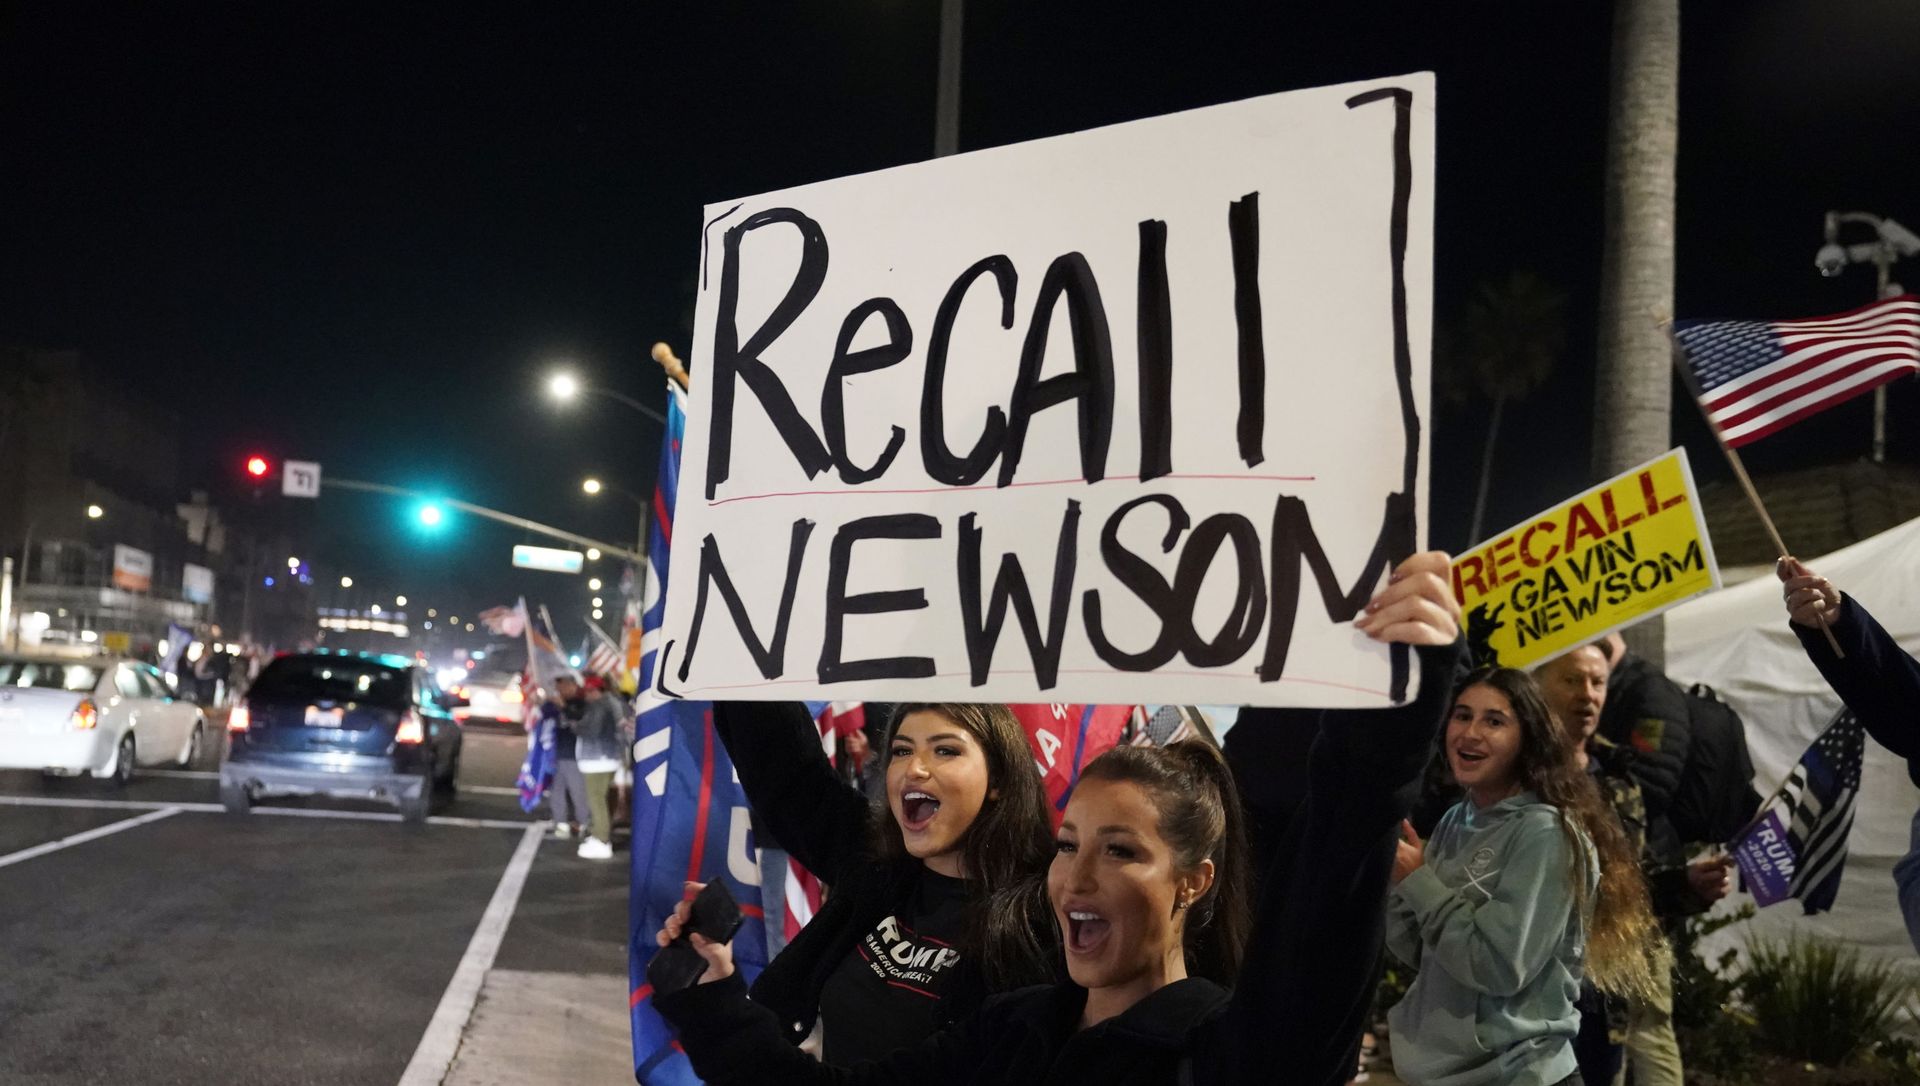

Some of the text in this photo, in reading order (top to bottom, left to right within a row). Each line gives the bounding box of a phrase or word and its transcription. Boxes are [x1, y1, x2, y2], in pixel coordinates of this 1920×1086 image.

[1452, 470, 1687, 607] RECALL
[678, 493, 1416, 698] NEWSOM
[1511, 531, 1635, 613] GAVIN
[1515, 538, 1704, 648] NEWSOM
[1747, 842, 1772, 871] 2020
[1758, 819, 1795, 882] RUM
[868, 941, 903, 979] AMERICA
[870, 961, 886, 978] 2020
[876, 915, 960, 973] RUMP
